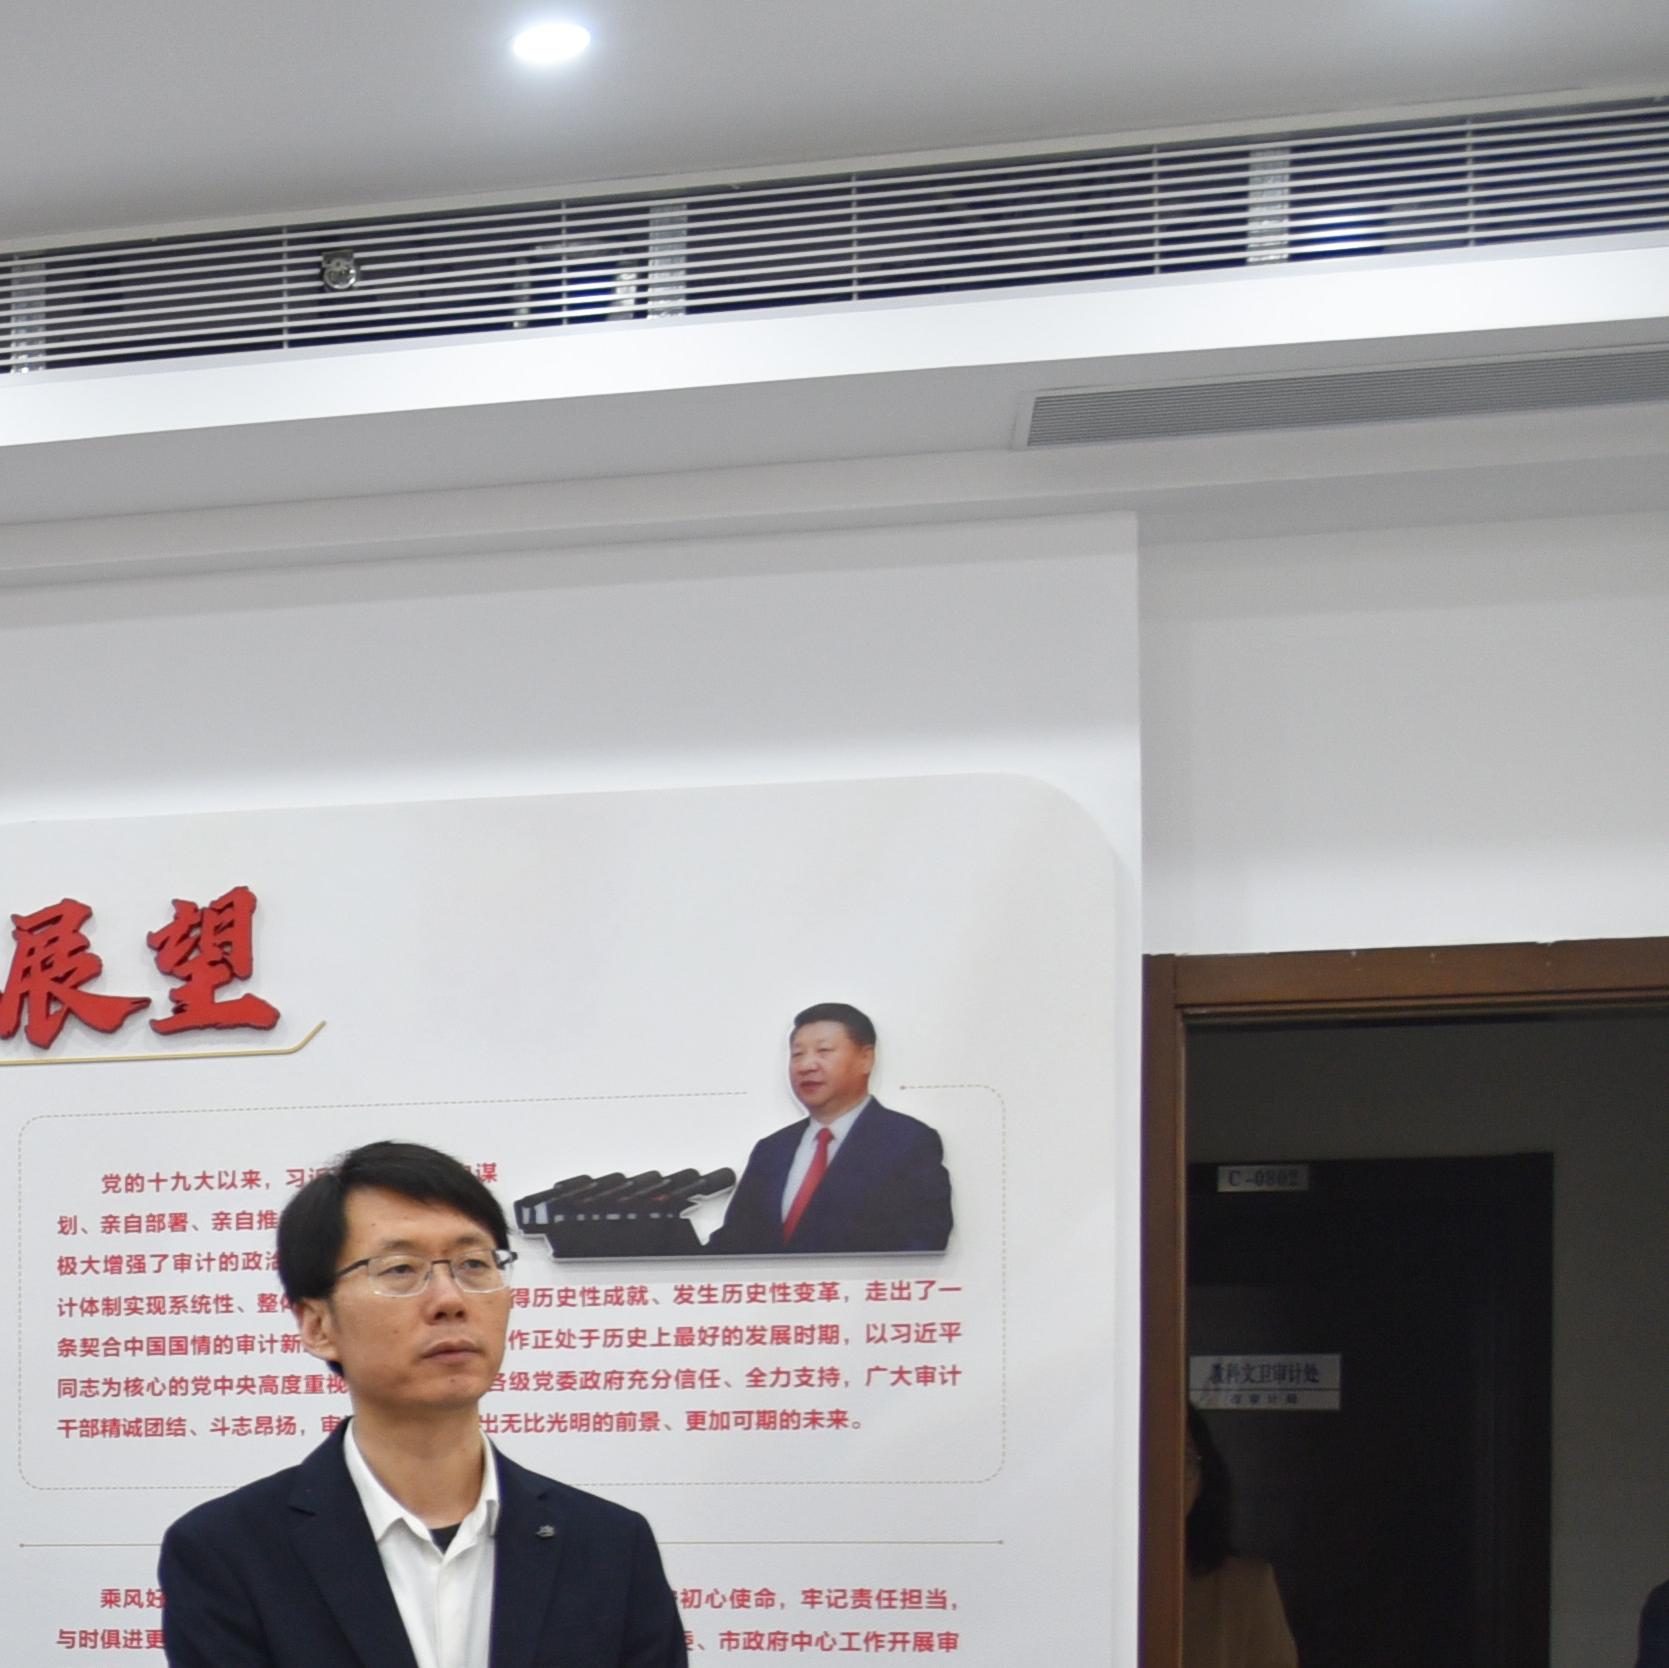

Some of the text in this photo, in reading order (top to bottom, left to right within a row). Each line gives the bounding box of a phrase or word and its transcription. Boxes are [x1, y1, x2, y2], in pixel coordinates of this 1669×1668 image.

[464, 1162, 498, 1183] 谋
[510, 1278, 963, 1310] 得历史性成就、发生历史性变革，走出了一
[56, 1321, 963, 1358] 条契合中国国情的审计新 作正处于历史上最好的发展时期，以习近平
[479, 1407, 865, 1435] 出无比光明的前景、更加可期的未来。
[672, 1587, 958, 1612] 初心使命，牢记责任担当，
